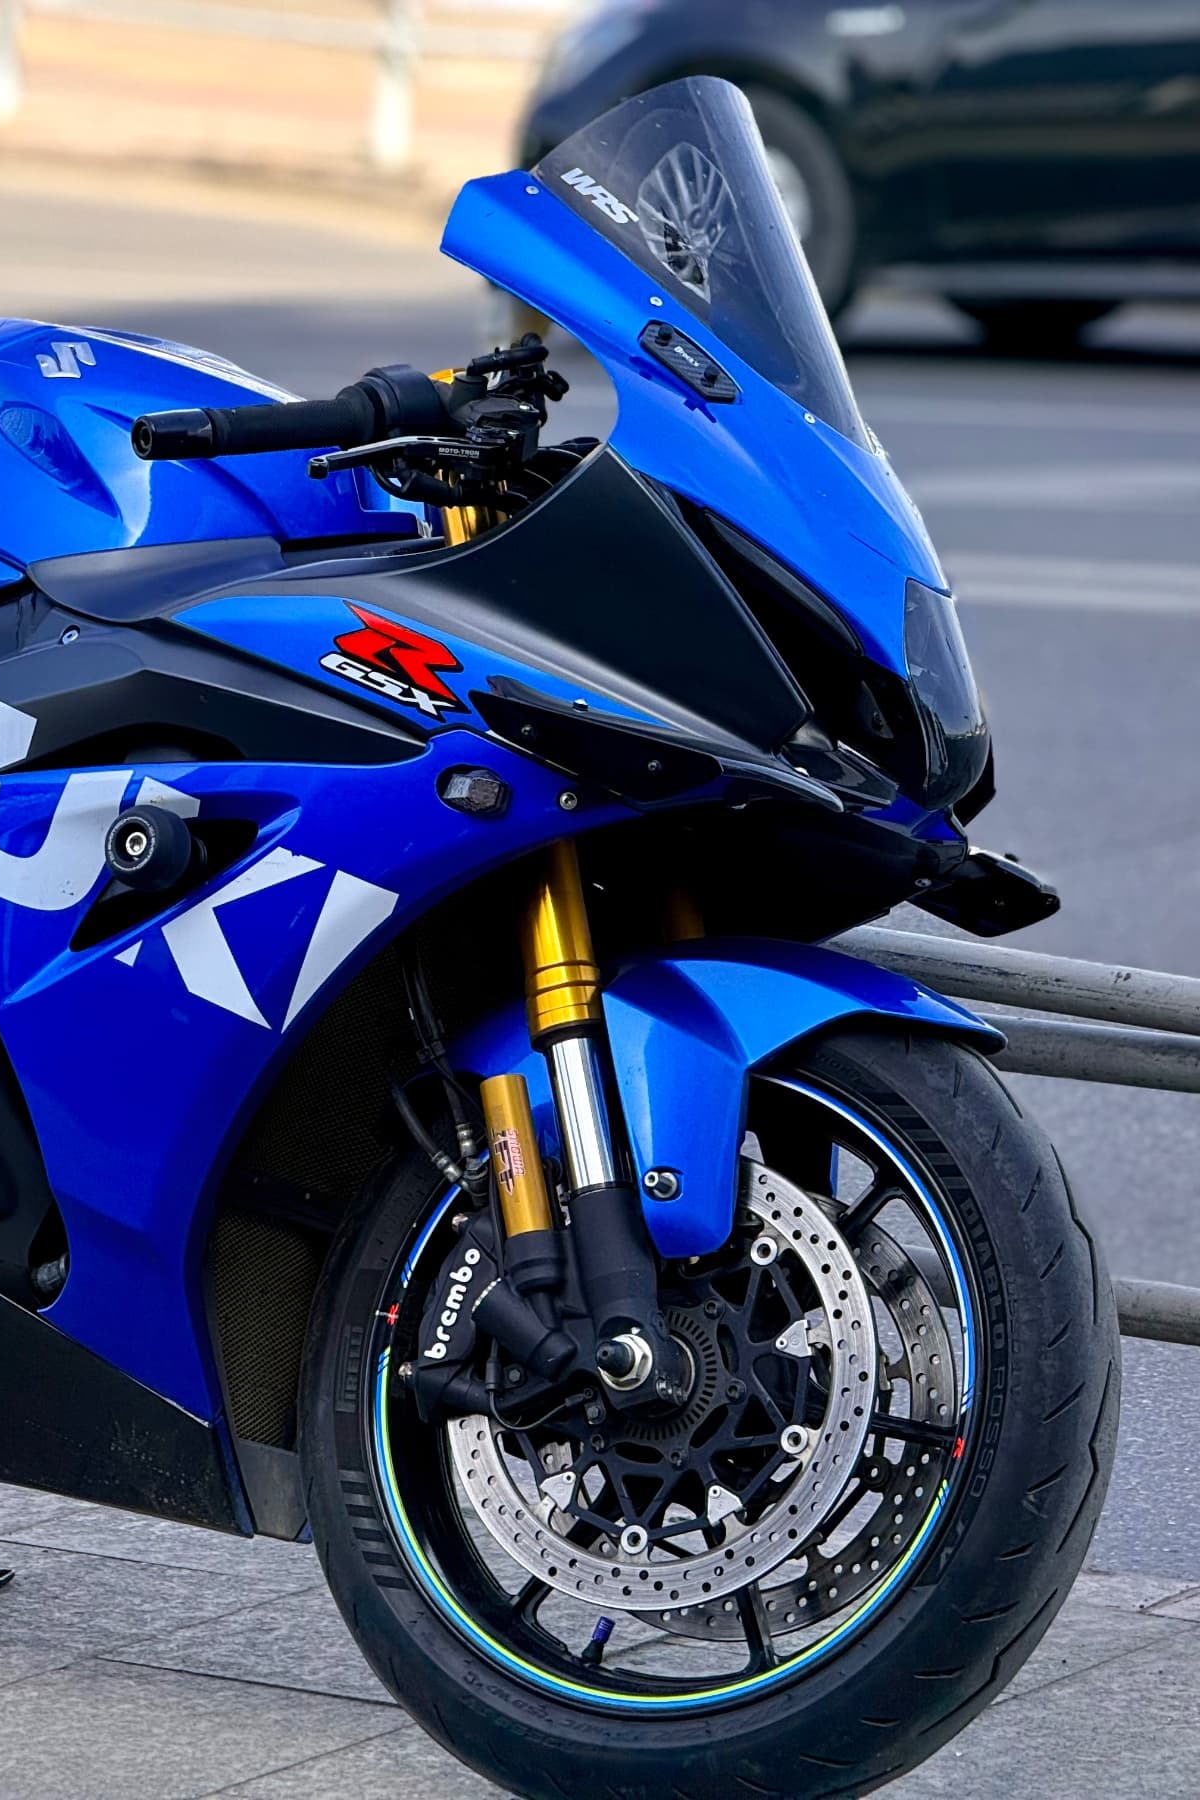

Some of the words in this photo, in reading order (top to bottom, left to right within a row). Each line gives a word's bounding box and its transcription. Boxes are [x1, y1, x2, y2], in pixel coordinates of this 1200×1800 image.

[561, 166, 639, 226] WRS
[319, 651, 459, 719] GSX
[336, 601, 466, 703] R
[424, 1247, 481, 1360] brembo
[959, 1196, 1005, 1351] DIABLO
[969, 1365, 1006, 1498] ROSSO
